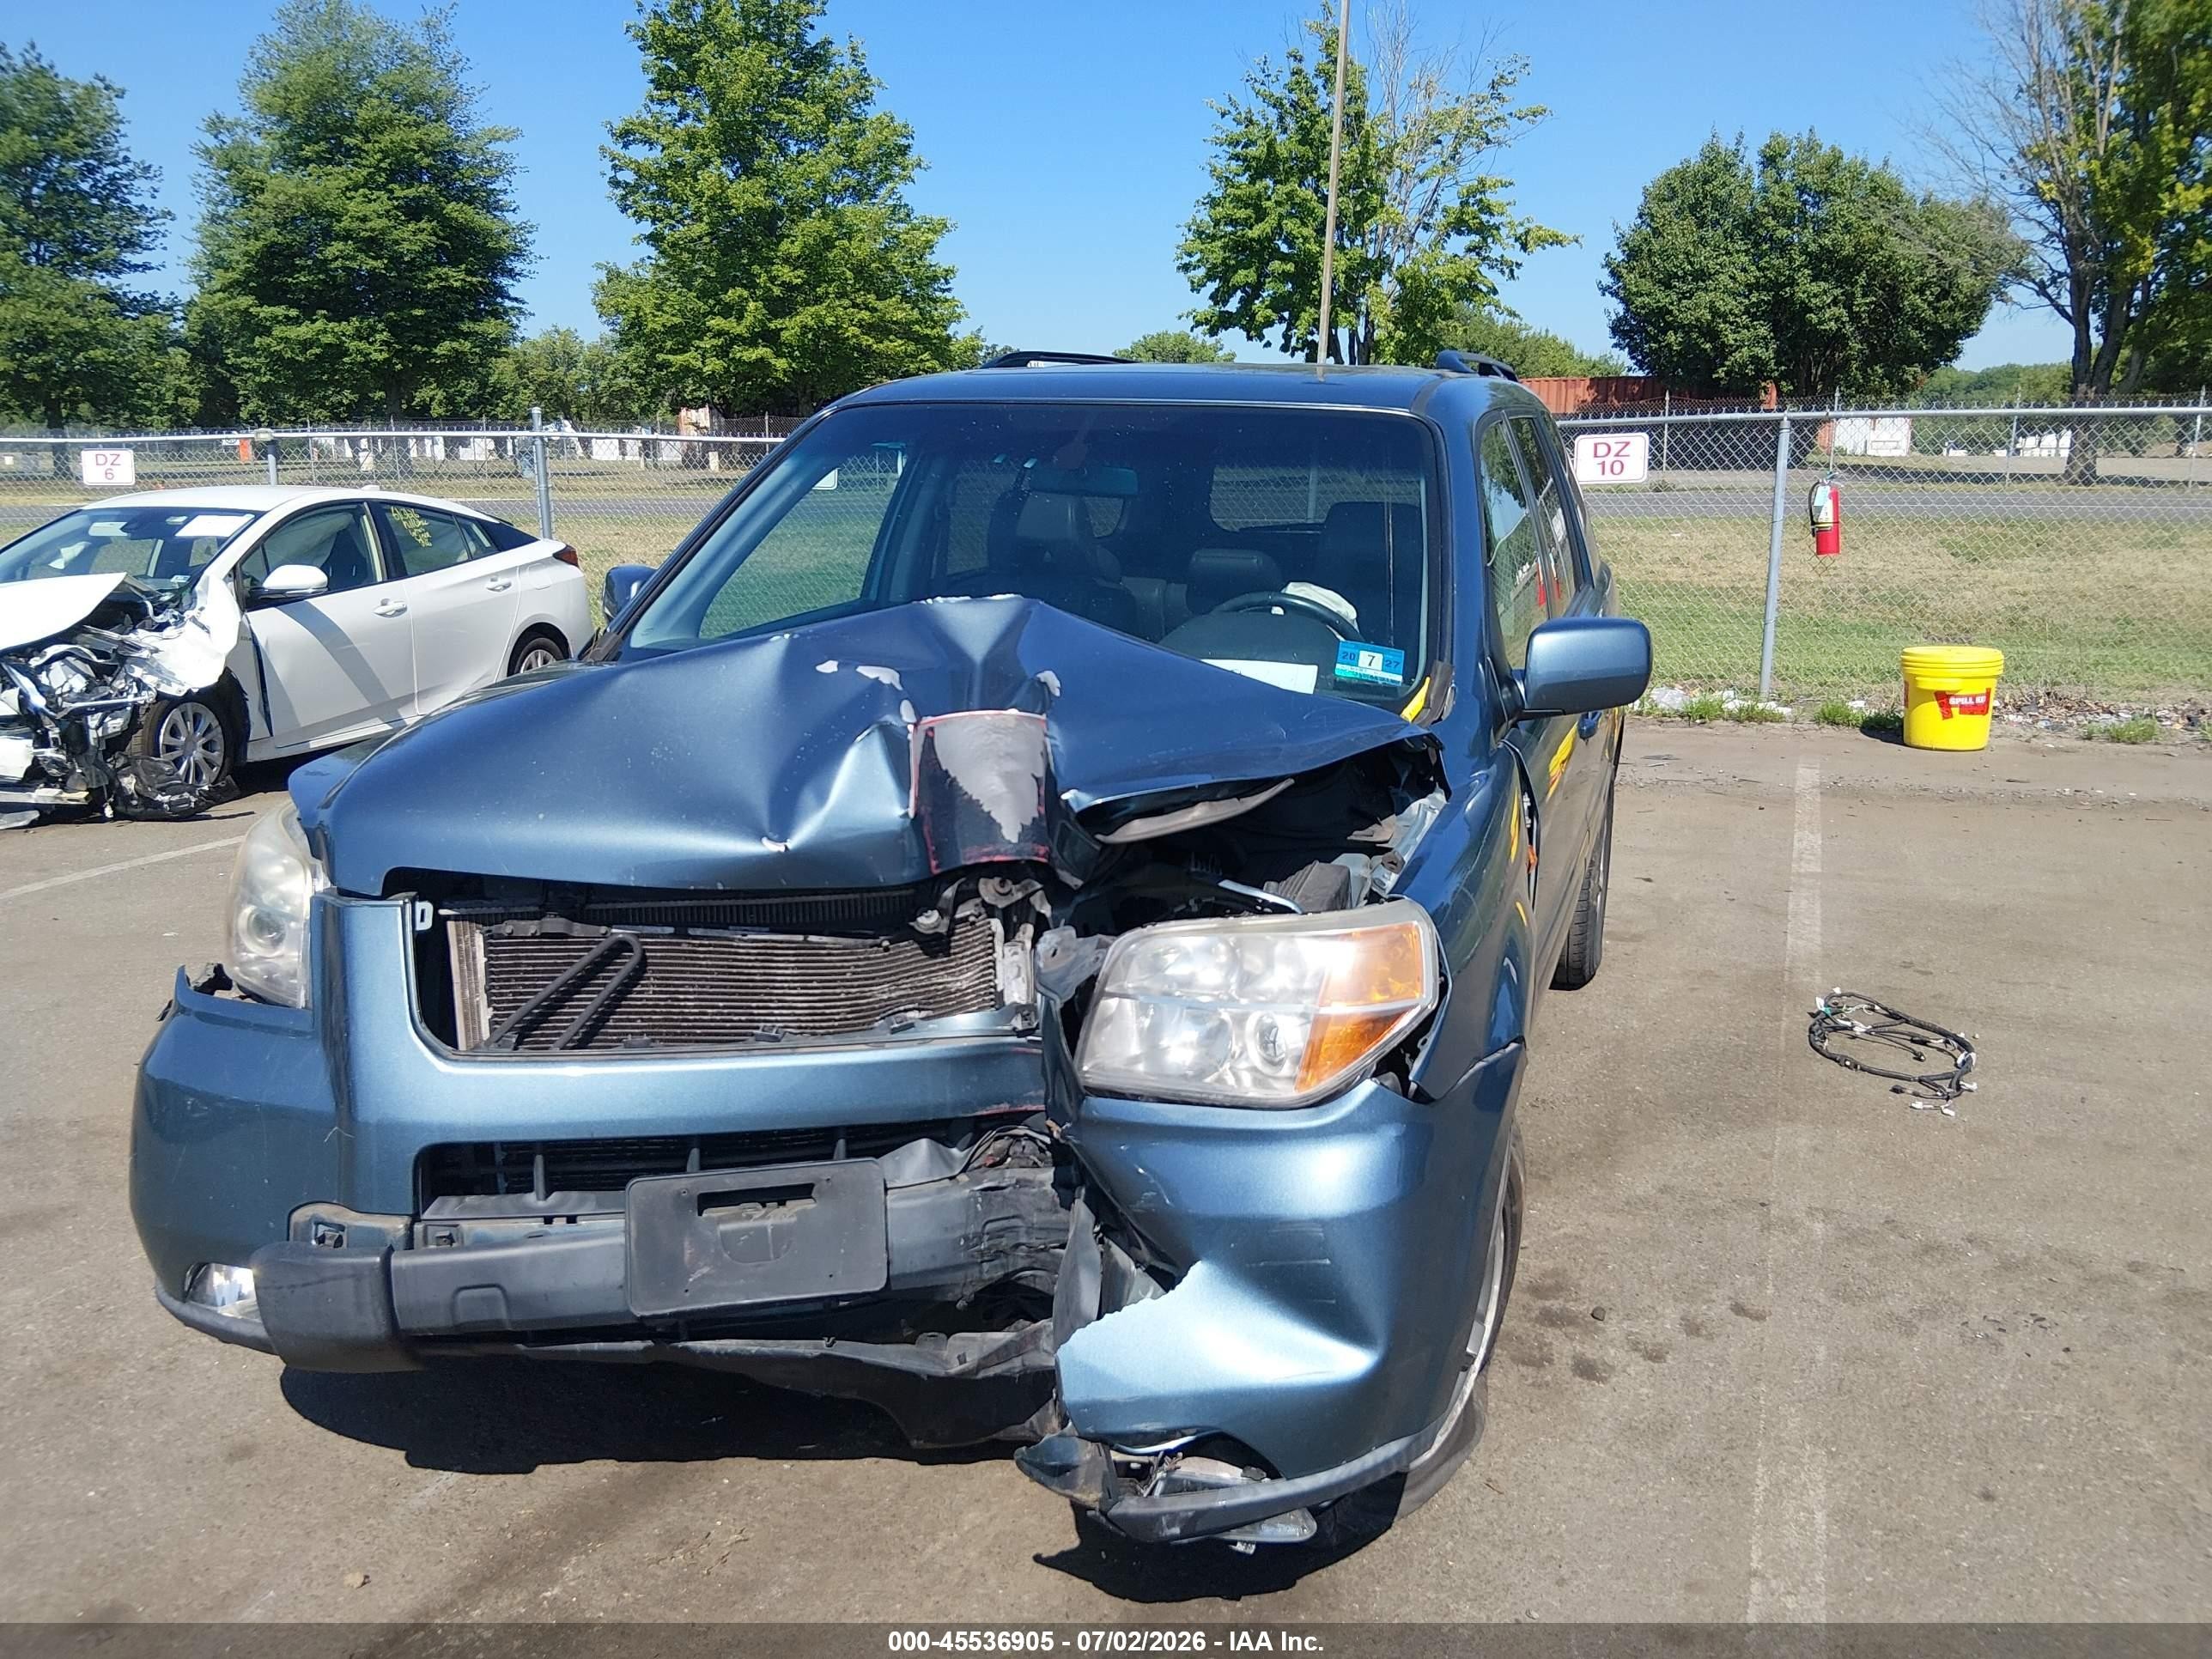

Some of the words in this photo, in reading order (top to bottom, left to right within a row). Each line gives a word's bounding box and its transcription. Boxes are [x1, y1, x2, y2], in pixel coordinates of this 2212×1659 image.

[1593, 441, 1631, 458] DZ
[95, 453, 121, 466] DZ
[104, 468, 114, 480] 6
[1596, 459, 1625, 476] 10
[1341, 651, 1356, 661] 20
[1367, 654, 1376, 667] 7
[1384, 659, 1401, 669] 27
[1948, 696, 1975, 705] SPILL
